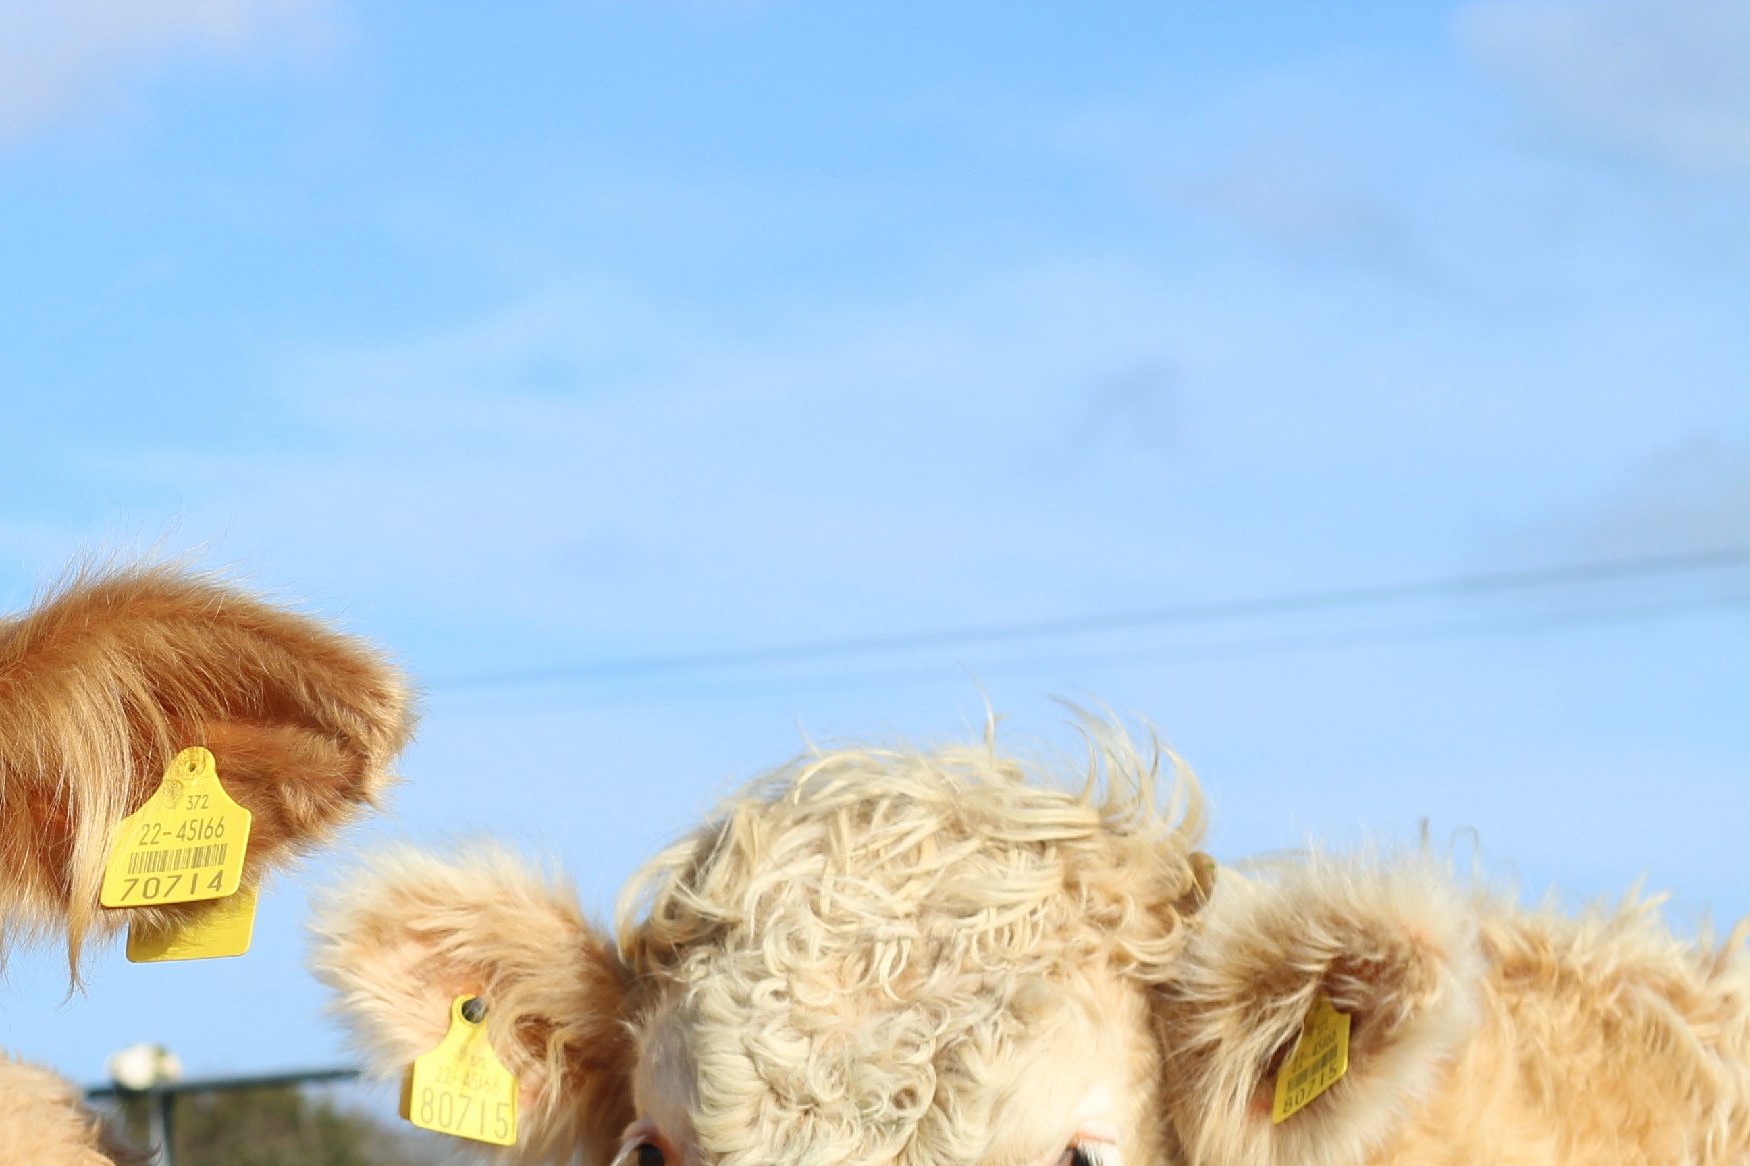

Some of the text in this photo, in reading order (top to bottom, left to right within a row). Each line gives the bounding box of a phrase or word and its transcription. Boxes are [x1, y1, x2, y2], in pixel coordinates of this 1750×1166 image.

[186, 795, 209, 811] 372
[139, 816, 225, 846] 22-45166
[120, 870, 224, 902] 70714
[420, 1087, 511, 1139] 80715
